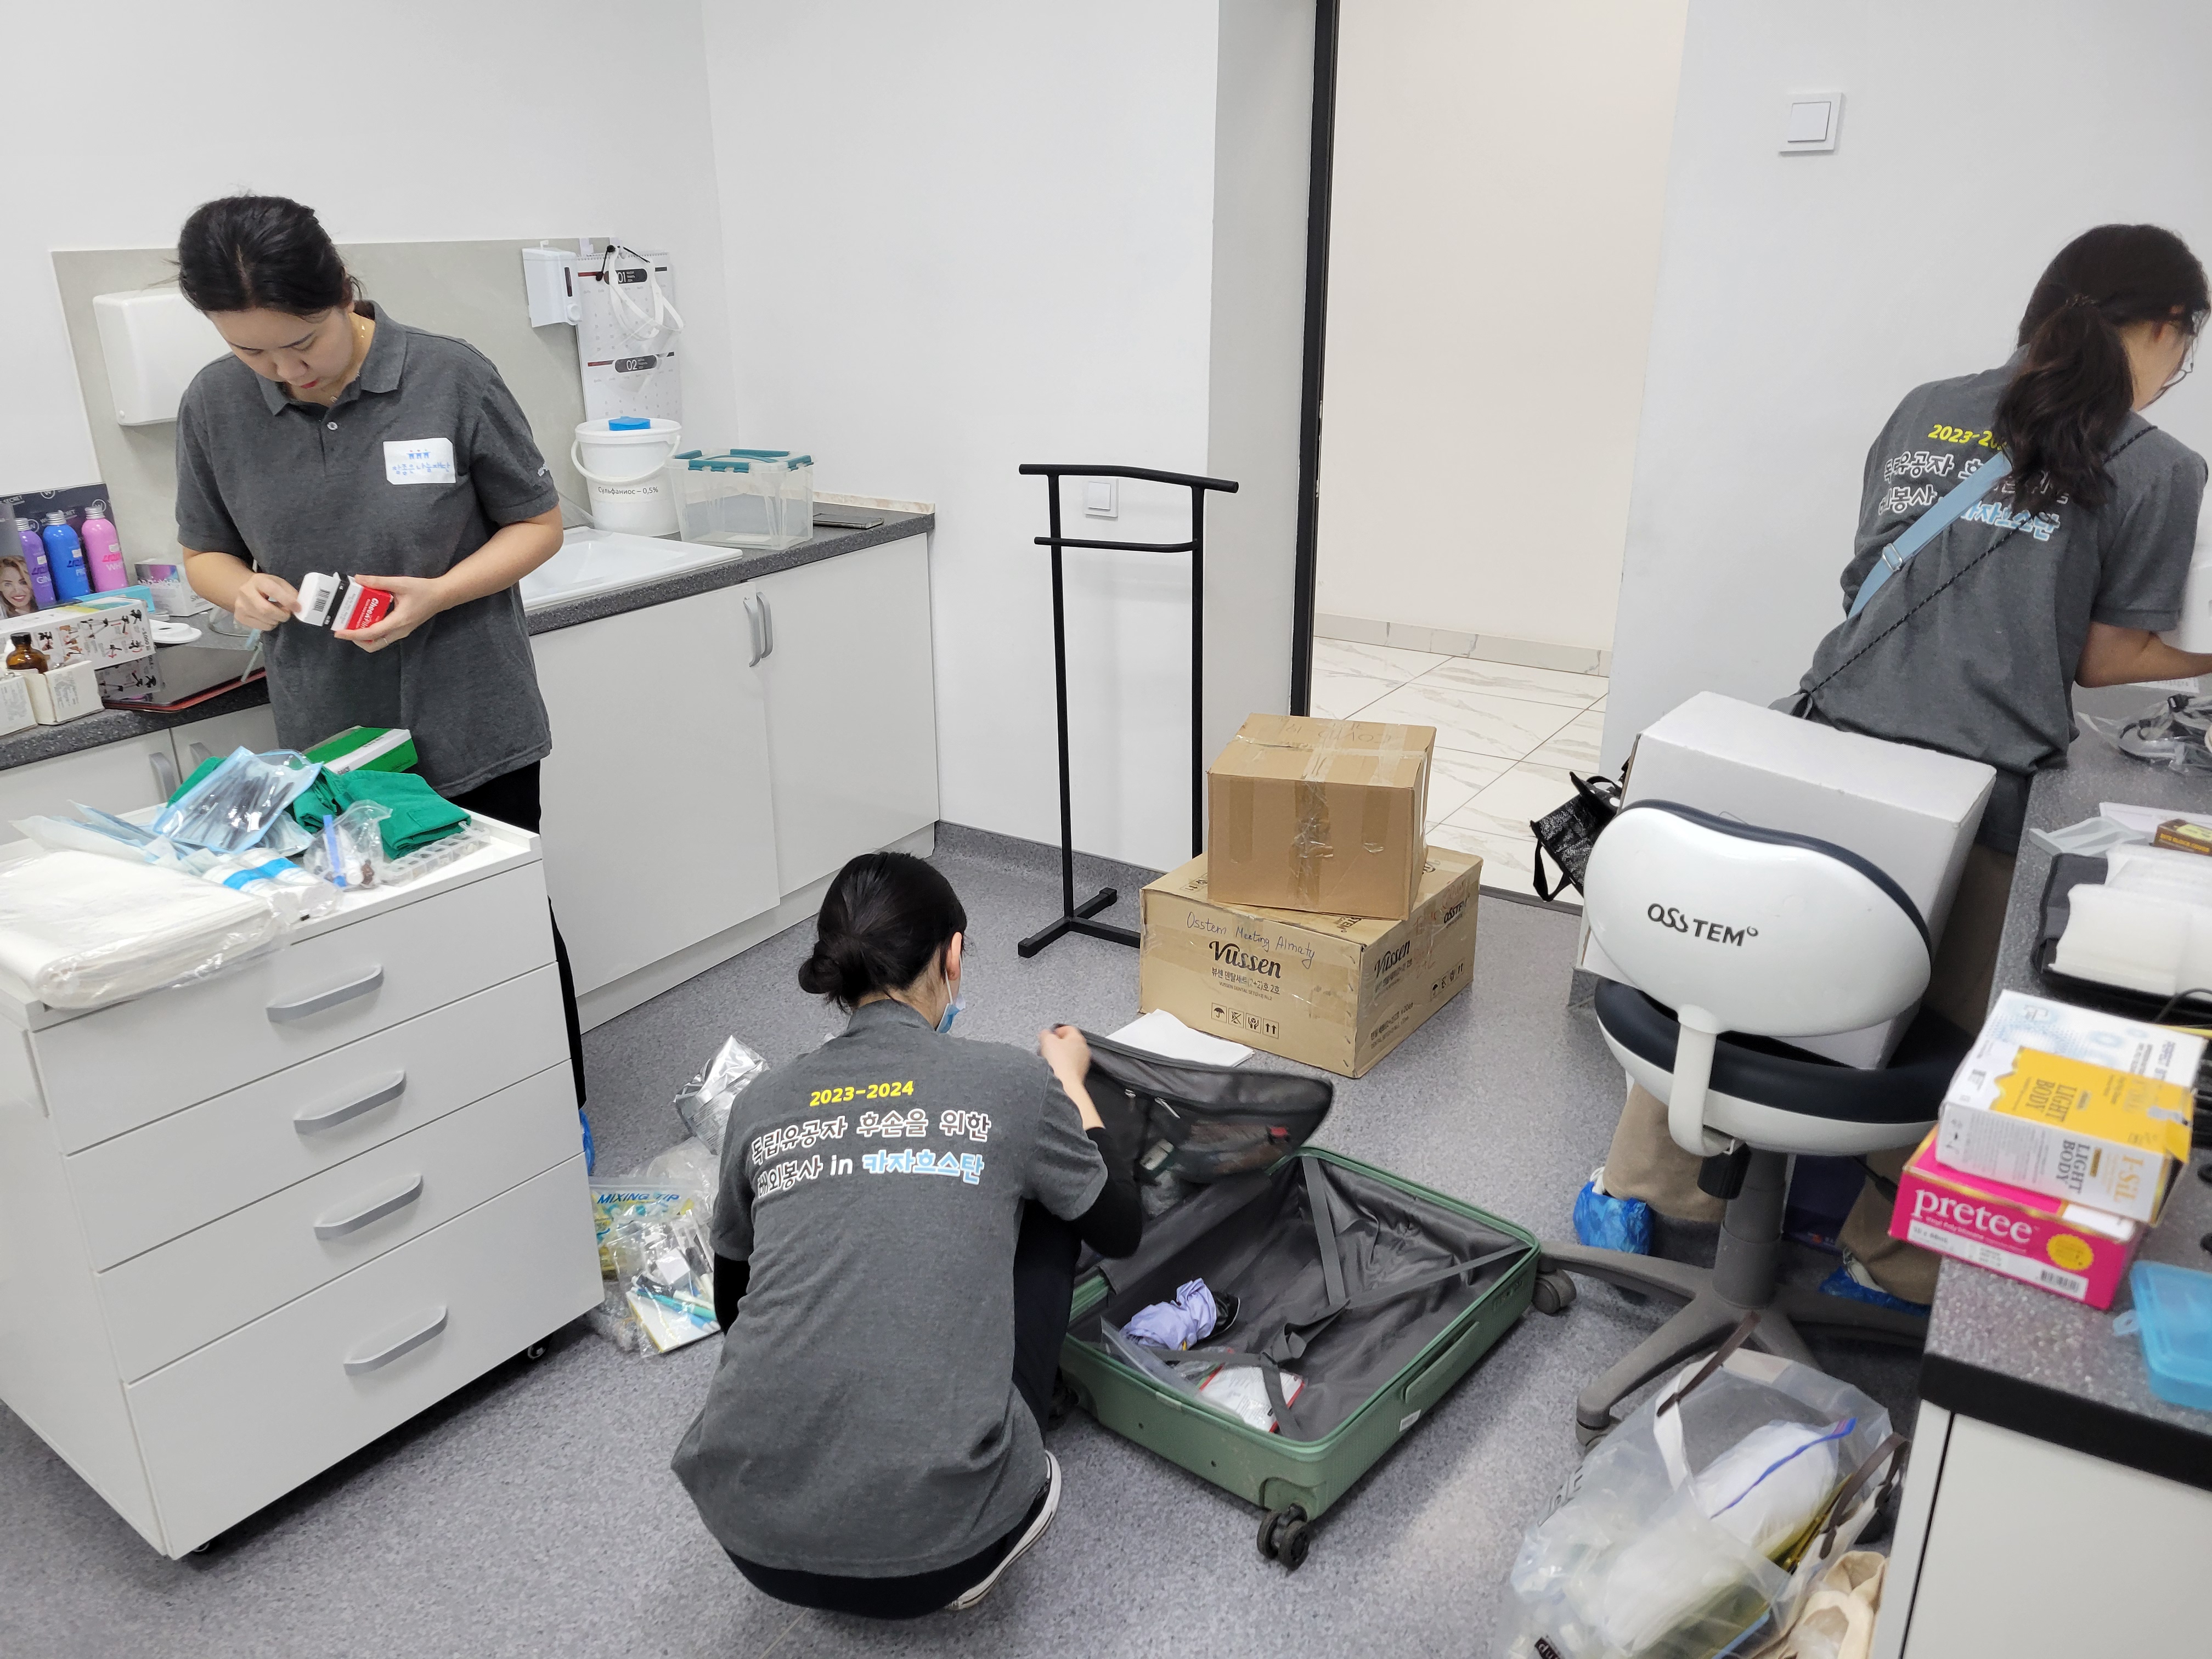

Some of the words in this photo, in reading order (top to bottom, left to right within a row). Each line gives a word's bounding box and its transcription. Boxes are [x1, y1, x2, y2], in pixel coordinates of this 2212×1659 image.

[626, 359, 638, 371] 02
[1927, 424, 2007, 451] 2023-20
[598, 487, 636, 495] Сульфаниос
[642, 486, 659, 495] 0,5%
[1186, 911, 1227, 935] Osstem
[1235, 926, 1271, 953] Meeting
[1275, 935, 1316, 970] Almaty
[1209, 940, 1282, 979] Vussen
[1374, 940, 1410, 978] Vussen
[1219, 981, 1234, 990] VUSSEN
[809, 1080, 915, 1107] 2023-2024
[2025, 1079, 2056, 1113] BODY
[2044, 1084, 2078, 1122] LIGHT
[751, 1115, 848, 1165] 독립유공자
[856, 1108, 929, 1138] 후손을
[939, 1109, 992, 1143] 위한
[830, 1155, 853, 1176] in
[862, 1148, 985, 1186] 카자흐스탄
[2055, 1139, 2076, 1183] BODY
[2068, 1142, 2091, 1195] LIGHT
[596, 1192, 650, 1204] MIXING
[655, 1193, 680, 1202] TIP
[1911, 1188, 2033, 1244] pretee
